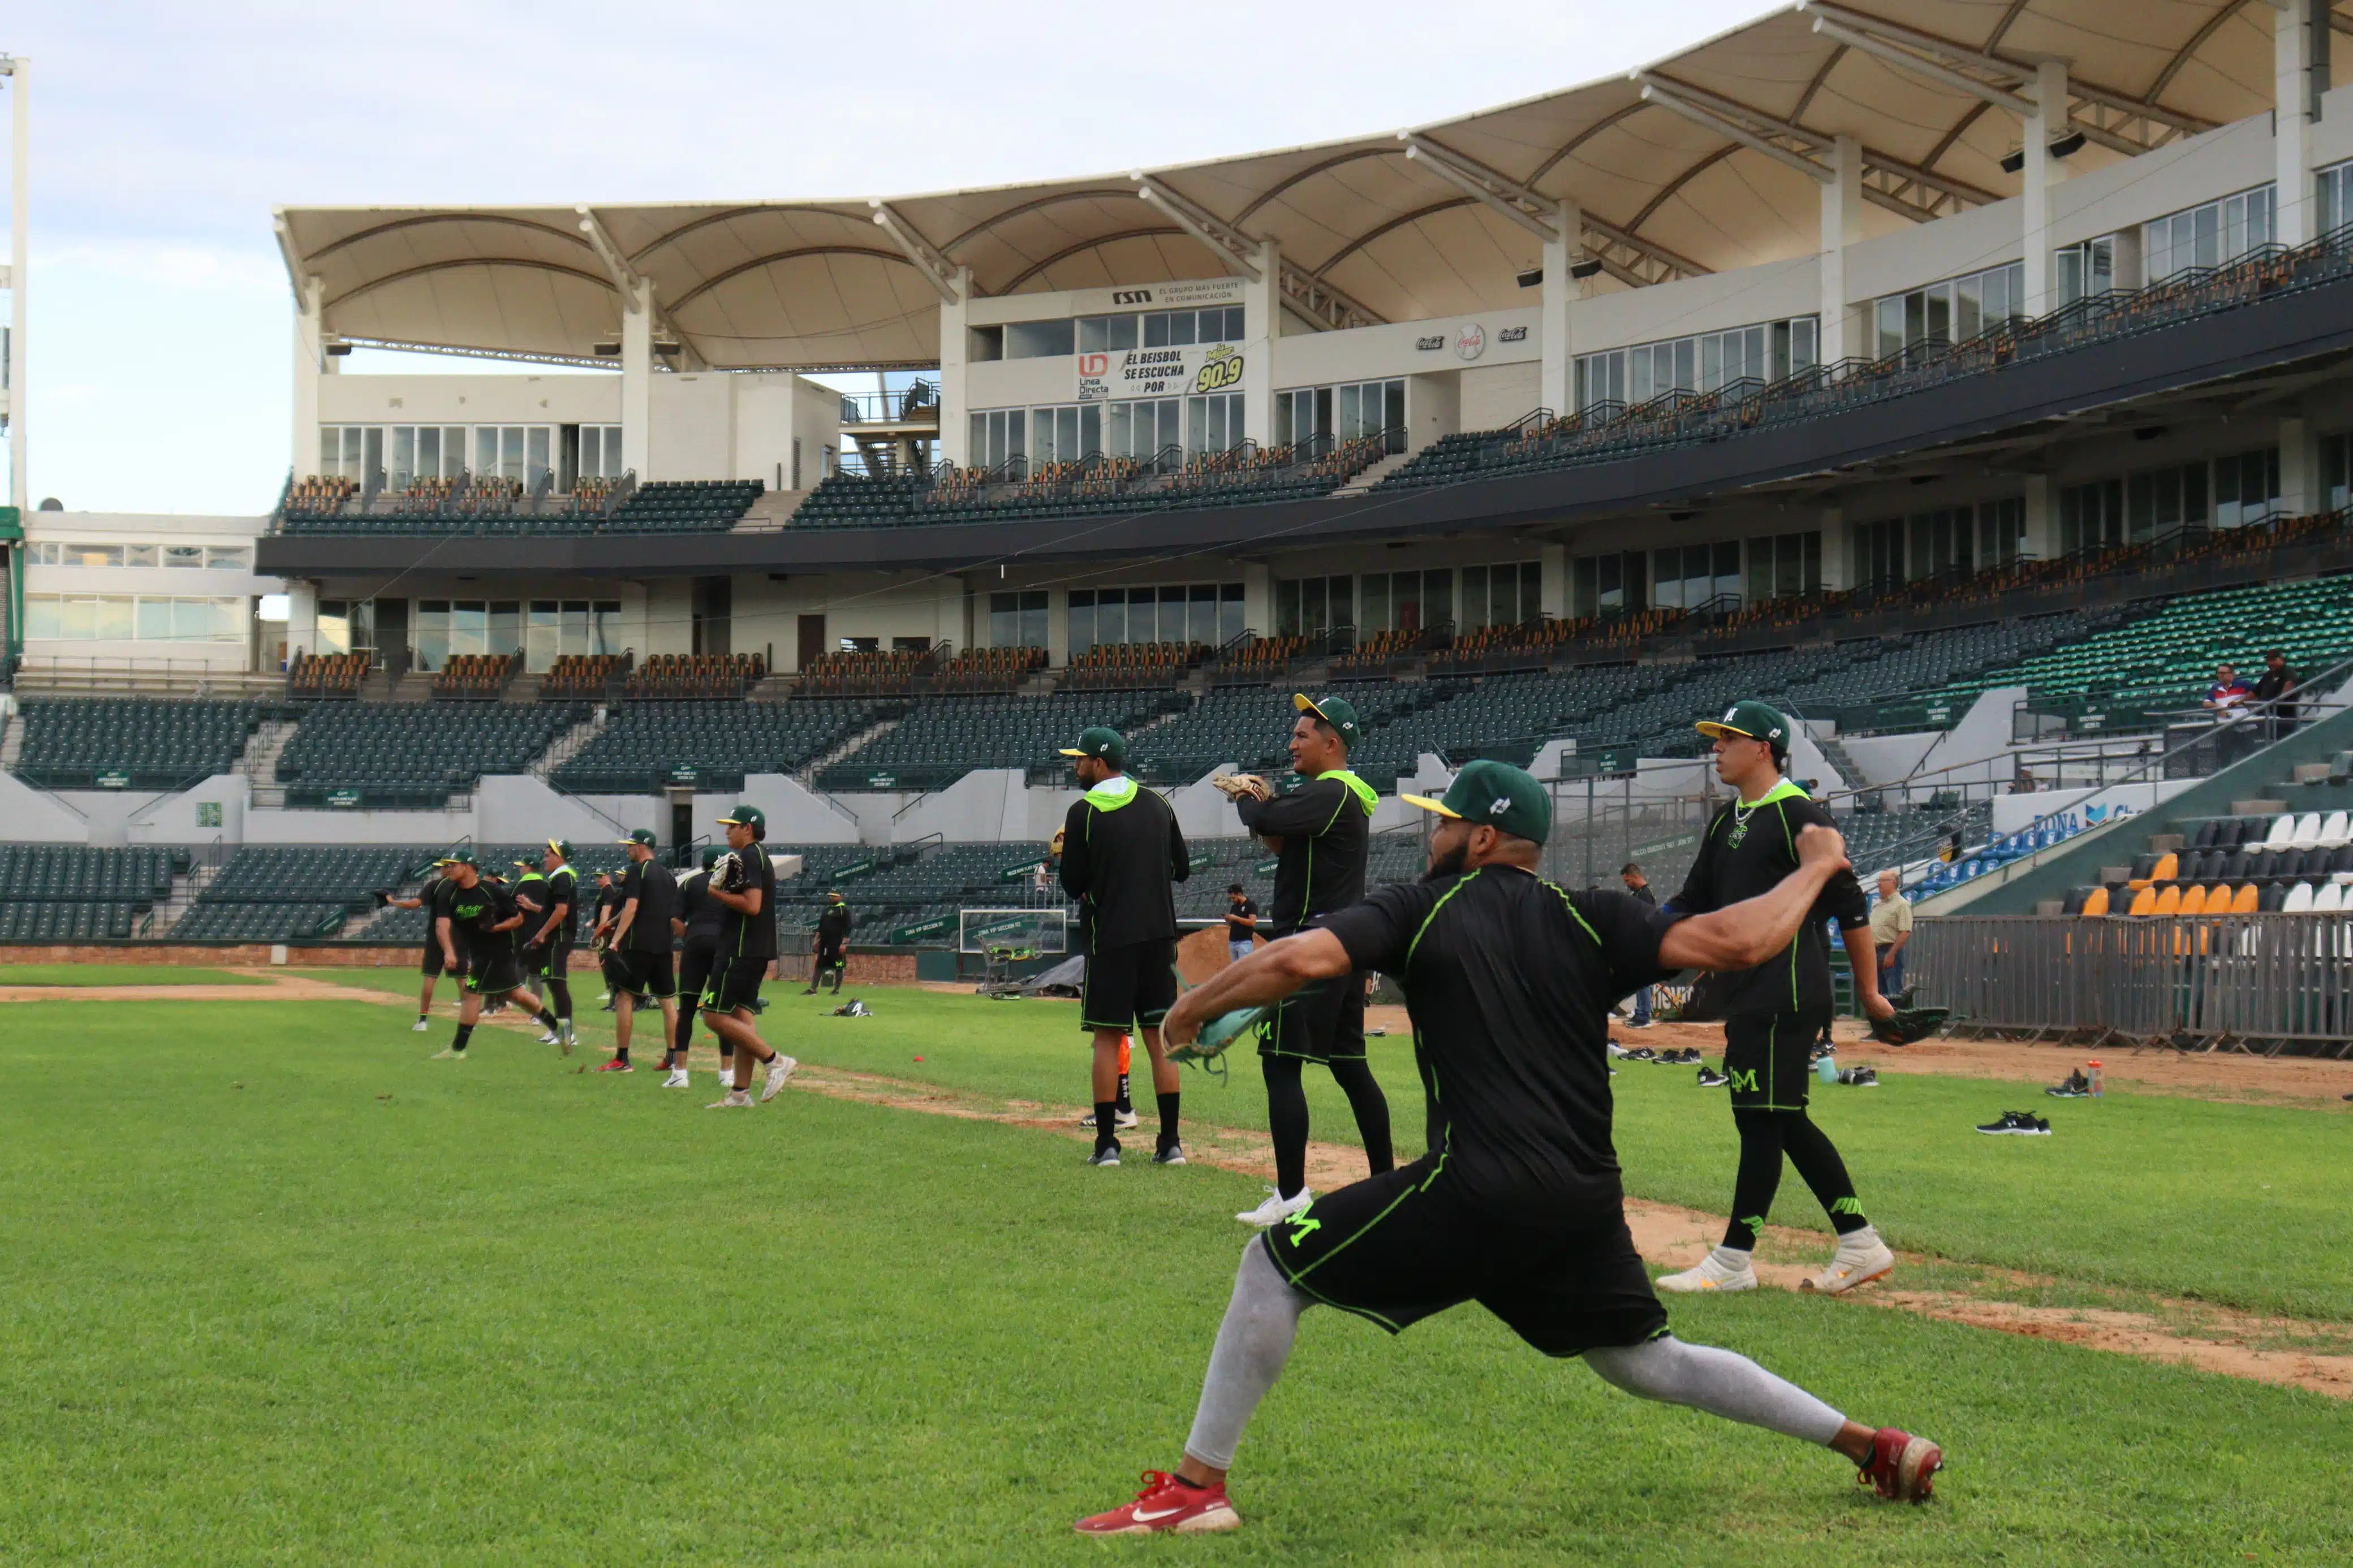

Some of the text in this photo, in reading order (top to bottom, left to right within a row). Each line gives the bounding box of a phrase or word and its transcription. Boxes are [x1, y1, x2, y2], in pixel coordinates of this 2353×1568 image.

[1169, 284, 1193, 293] GRUPO
[1212, 282, 1239, 290] FUERTE
[1165, 295, 1174, 303] EN
[1126, 351, 1182, 365] EL BEISBOL
[1124, 365, 1184, 380] SE ESCUCHA
[1196, 355, 1244, 393] 90.9
[1079, 385, 1109, 394] Directa
[1144, 381, 1165, 392] POR
